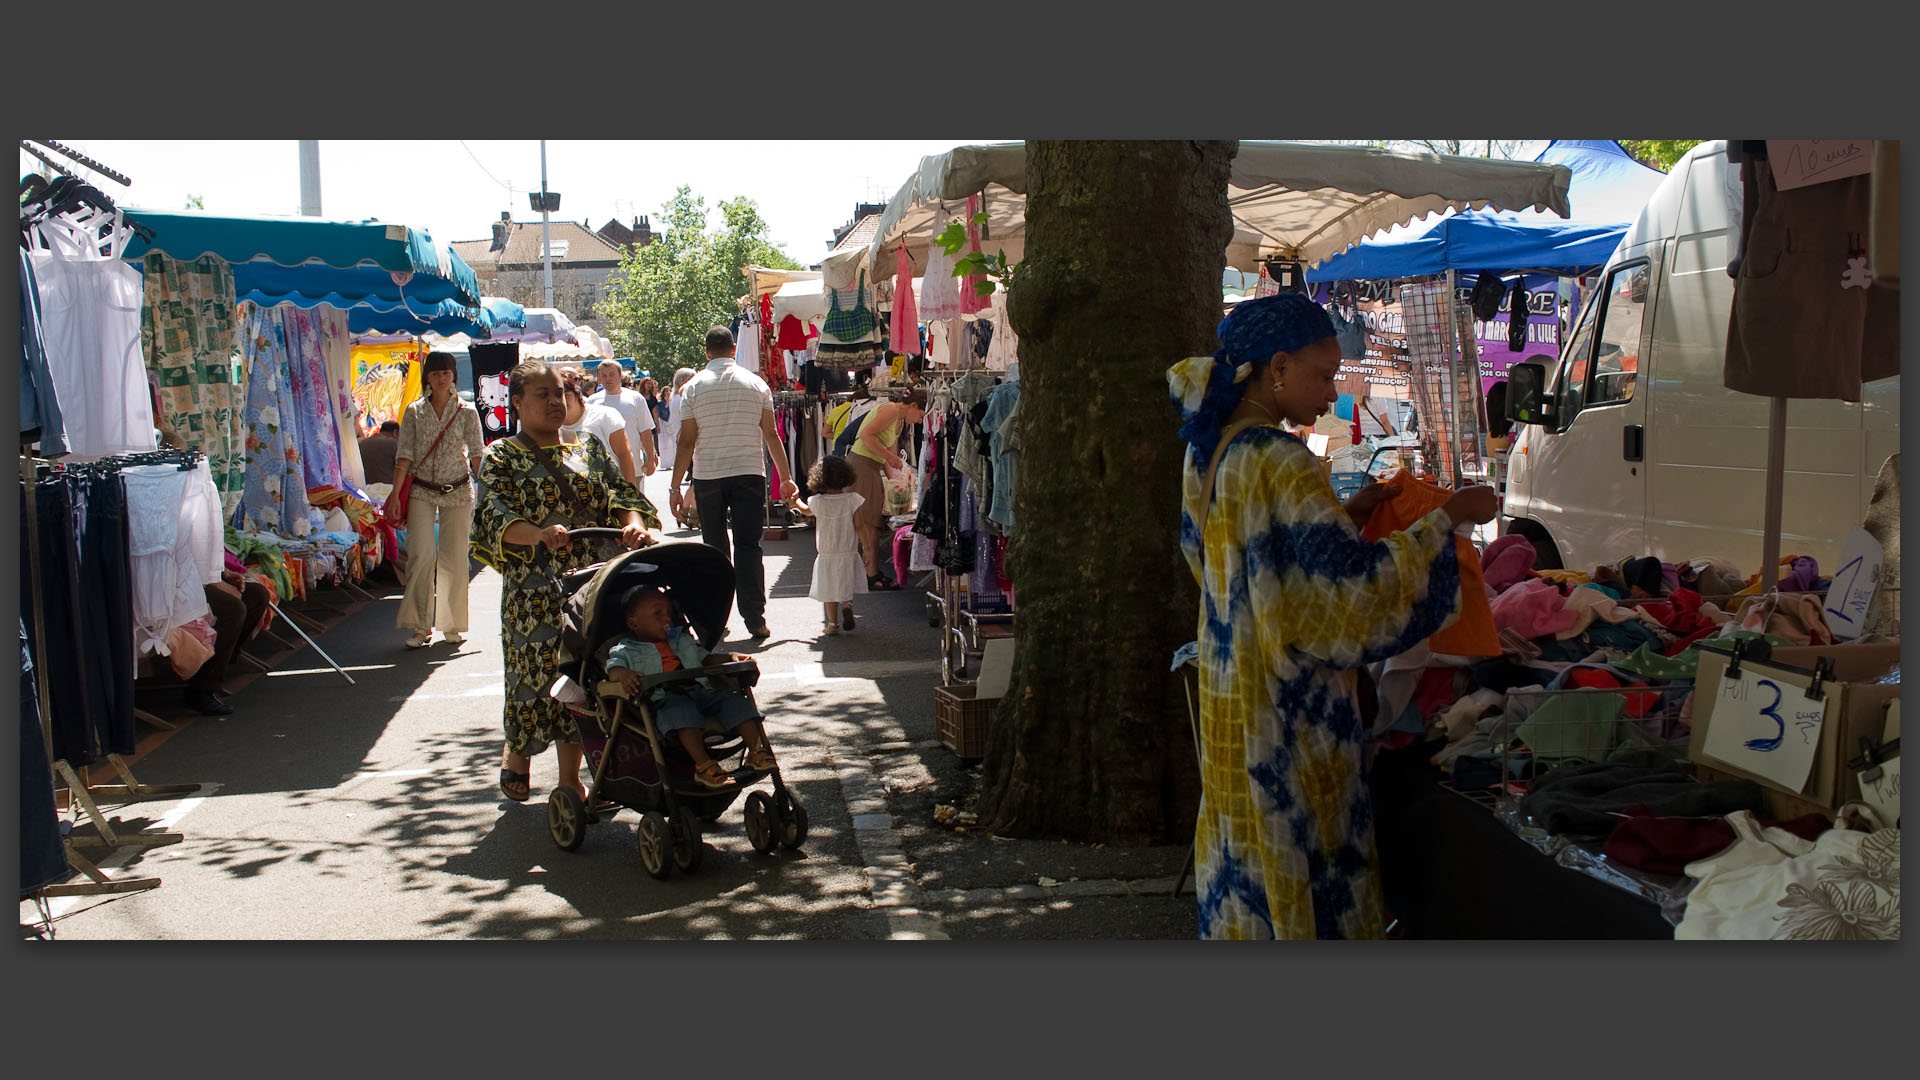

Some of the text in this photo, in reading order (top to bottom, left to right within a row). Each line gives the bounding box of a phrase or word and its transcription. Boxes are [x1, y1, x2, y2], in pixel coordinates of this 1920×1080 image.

[1785, 144, 1817, 176] 10
[1528, 322, 1536, 343] A
[1537, 323, 1557, 344] LILLE
[1364, 349, 1383, 358] AGE
[1339, 366, 1377, 374] RODUITS
[1825, 555, 1864, 625] 1
[1743, 679, 1785, 752] 3
